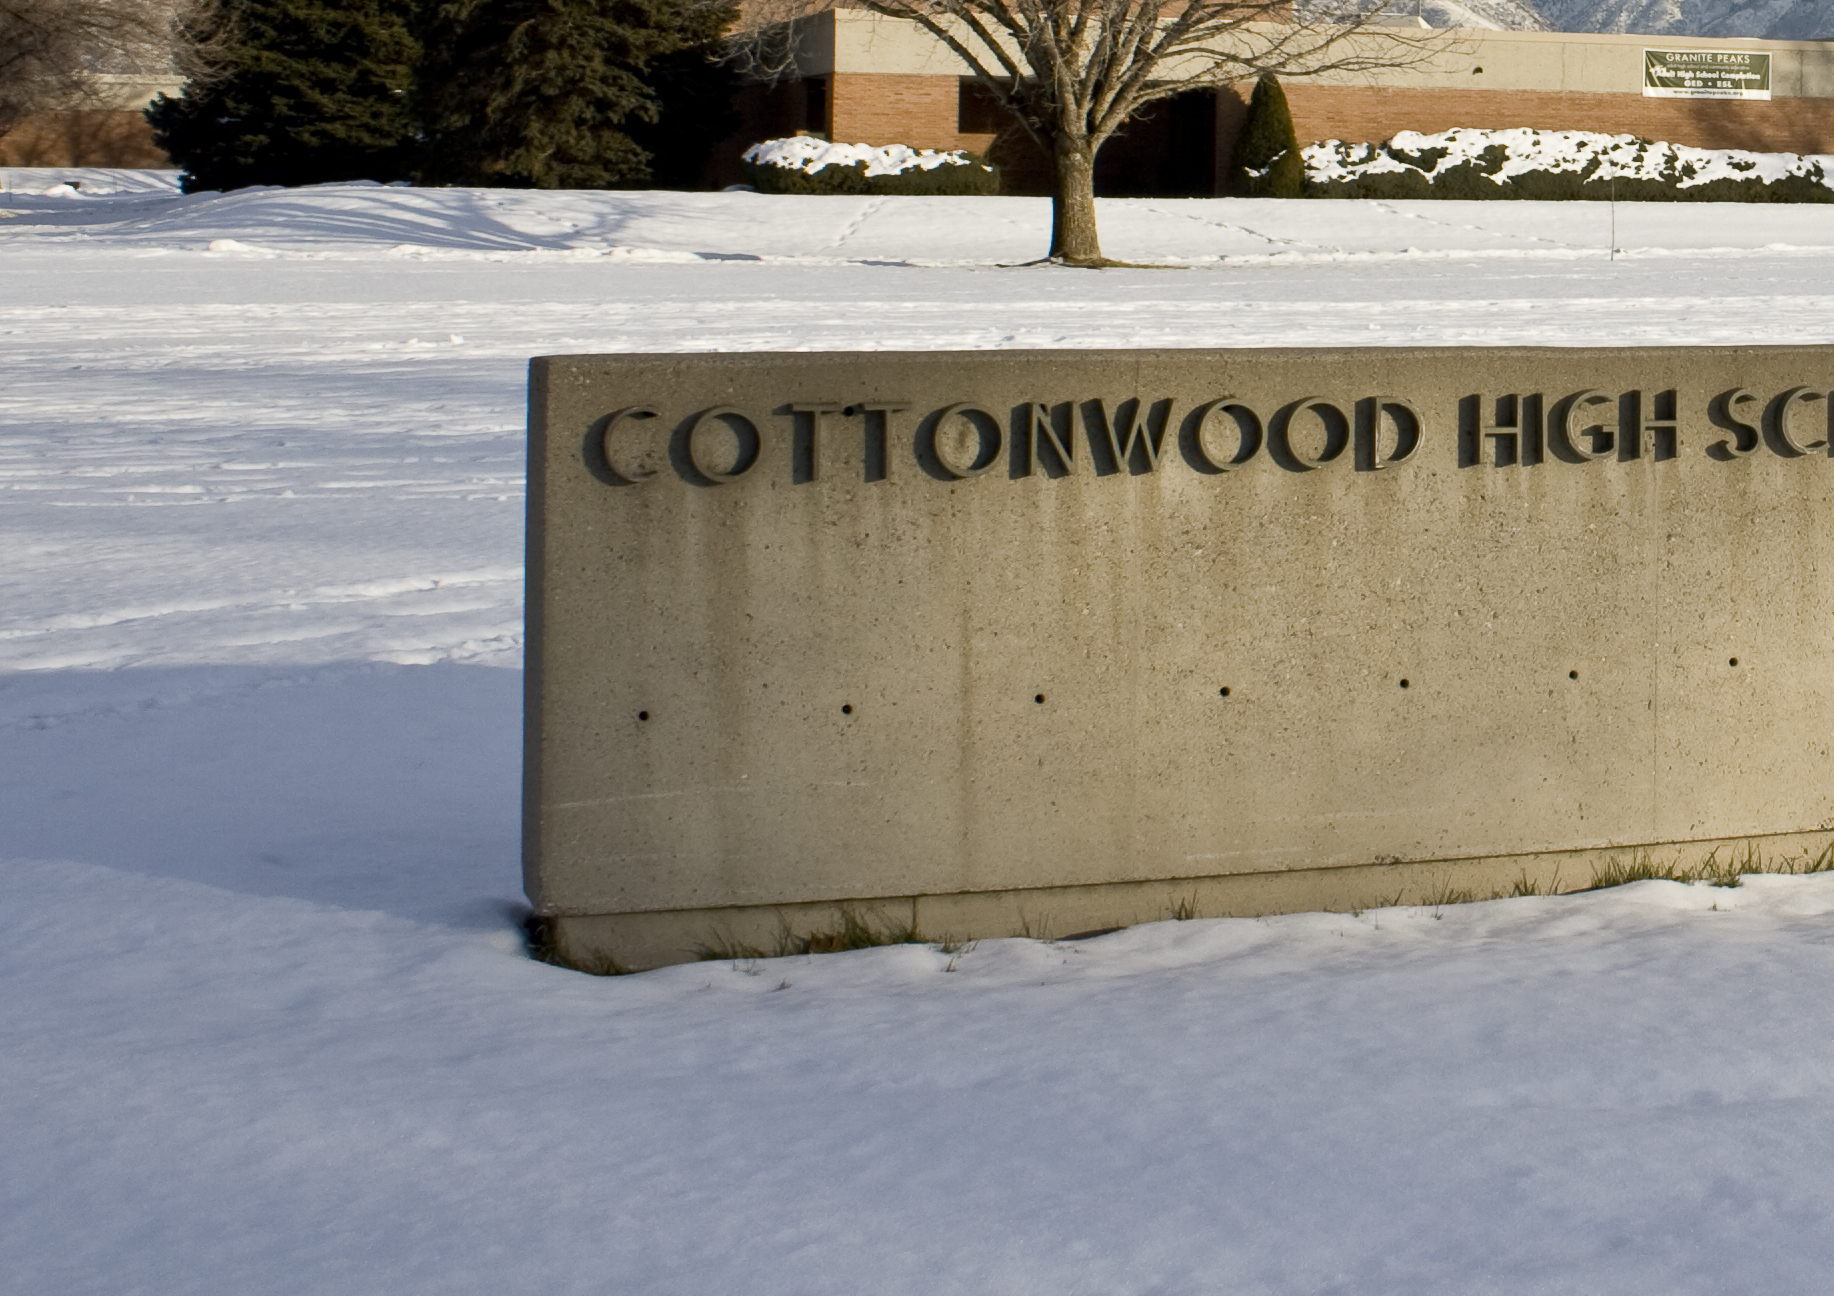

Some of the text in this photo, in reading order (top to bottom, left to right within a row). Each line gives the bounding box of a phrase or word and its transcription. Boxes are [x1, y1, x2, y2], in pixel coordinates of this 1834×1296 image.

[1666, 53, 1750, 64] GRANITE PEAKS
[1677, 70, 1694, 80] High
[1696, 70, 1719, 79] School
[1720, 71, 1761, 81] Completion
[1716, 80, 1733, 88] ESL
[583, 395, 1425, 486] COTTONWOOD
[1458, 388, 1678, 468] HIGH
